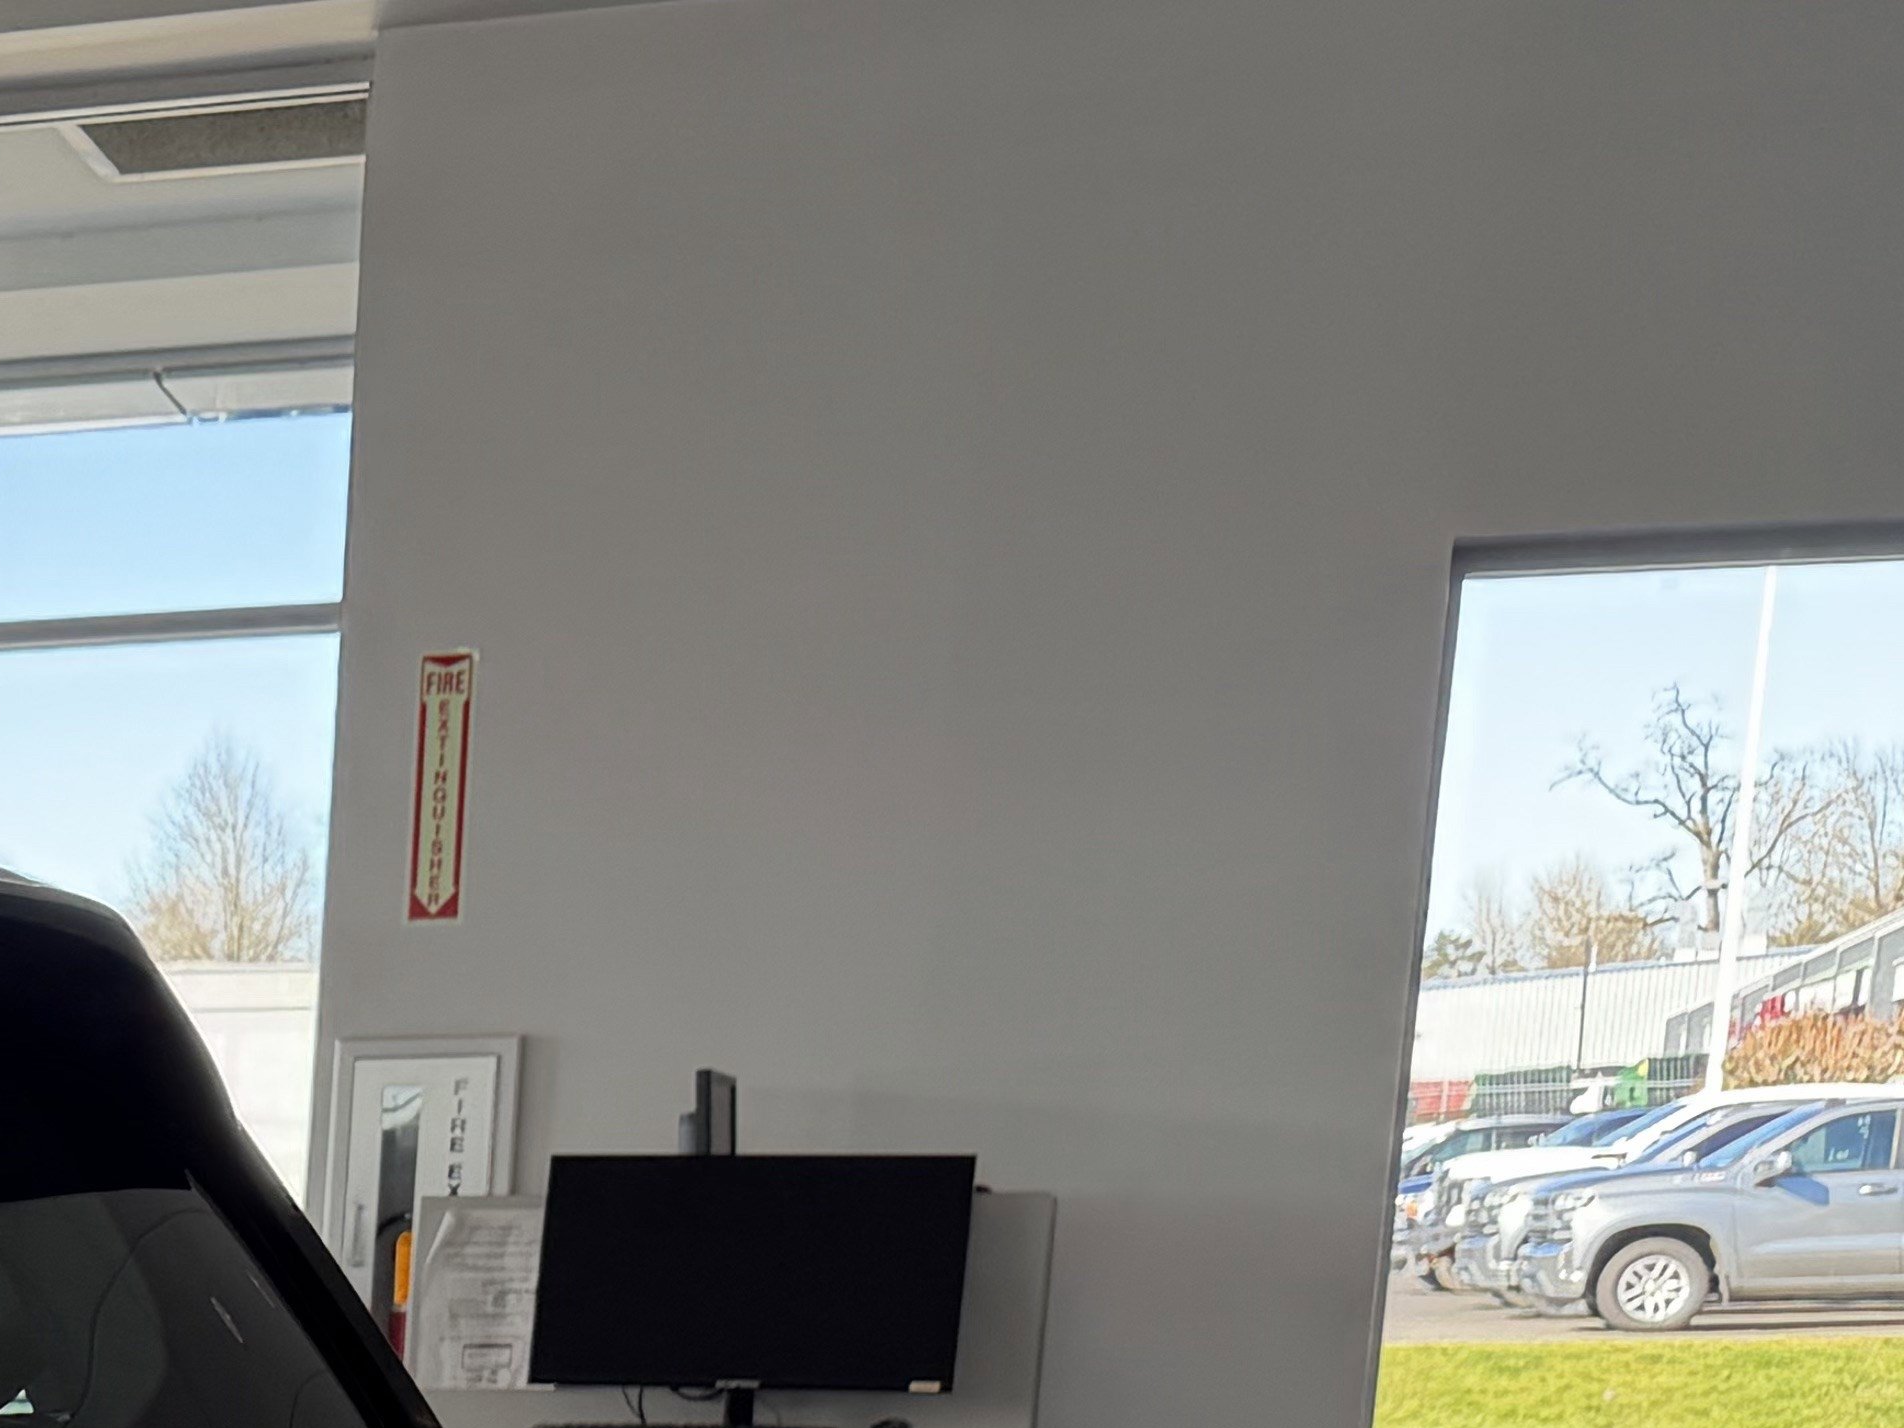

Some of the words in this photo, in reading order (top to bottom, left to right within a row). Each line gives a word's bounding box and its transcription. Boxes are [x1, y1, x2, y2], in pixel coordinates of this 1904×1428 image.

[425, 670, 466, 696] FIRE
[427, 699, 450, 907] EXTINGUISHER
[449, 1077, 469, 1153] FIRE
